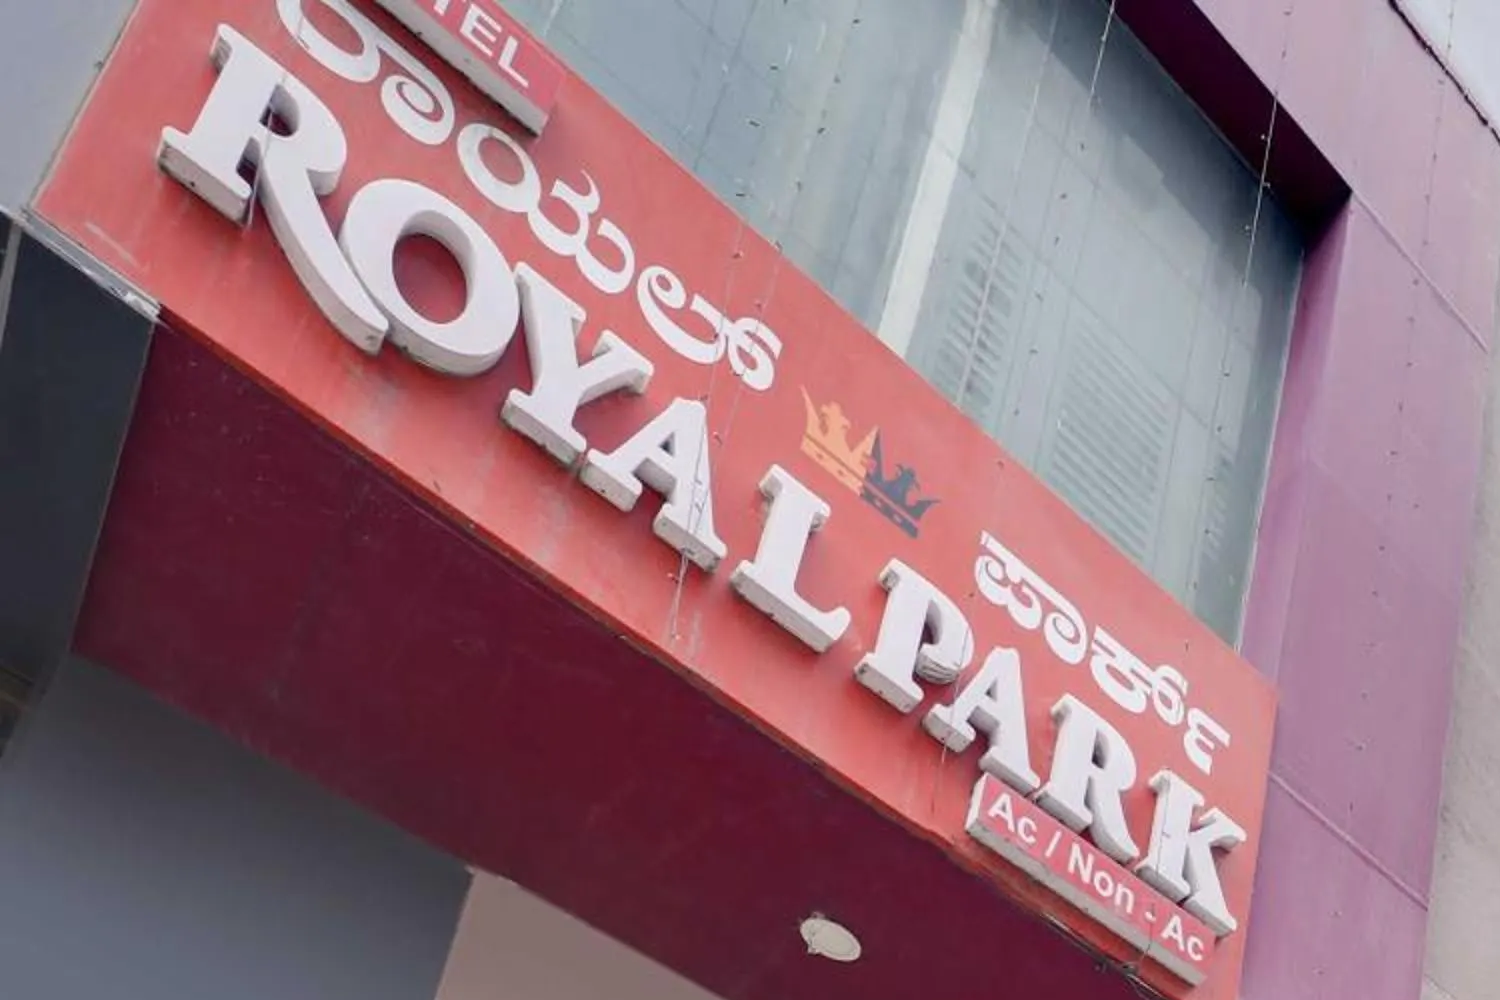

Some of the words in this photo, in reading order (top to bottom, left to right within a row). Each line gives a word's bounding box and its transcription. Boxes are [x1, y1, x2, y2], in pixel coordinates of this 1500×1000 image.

[157, 24, 851, 654] ROYAL
[853, 558, 1247, 937] PARK
[1068, 843, 1135, 914] Non
